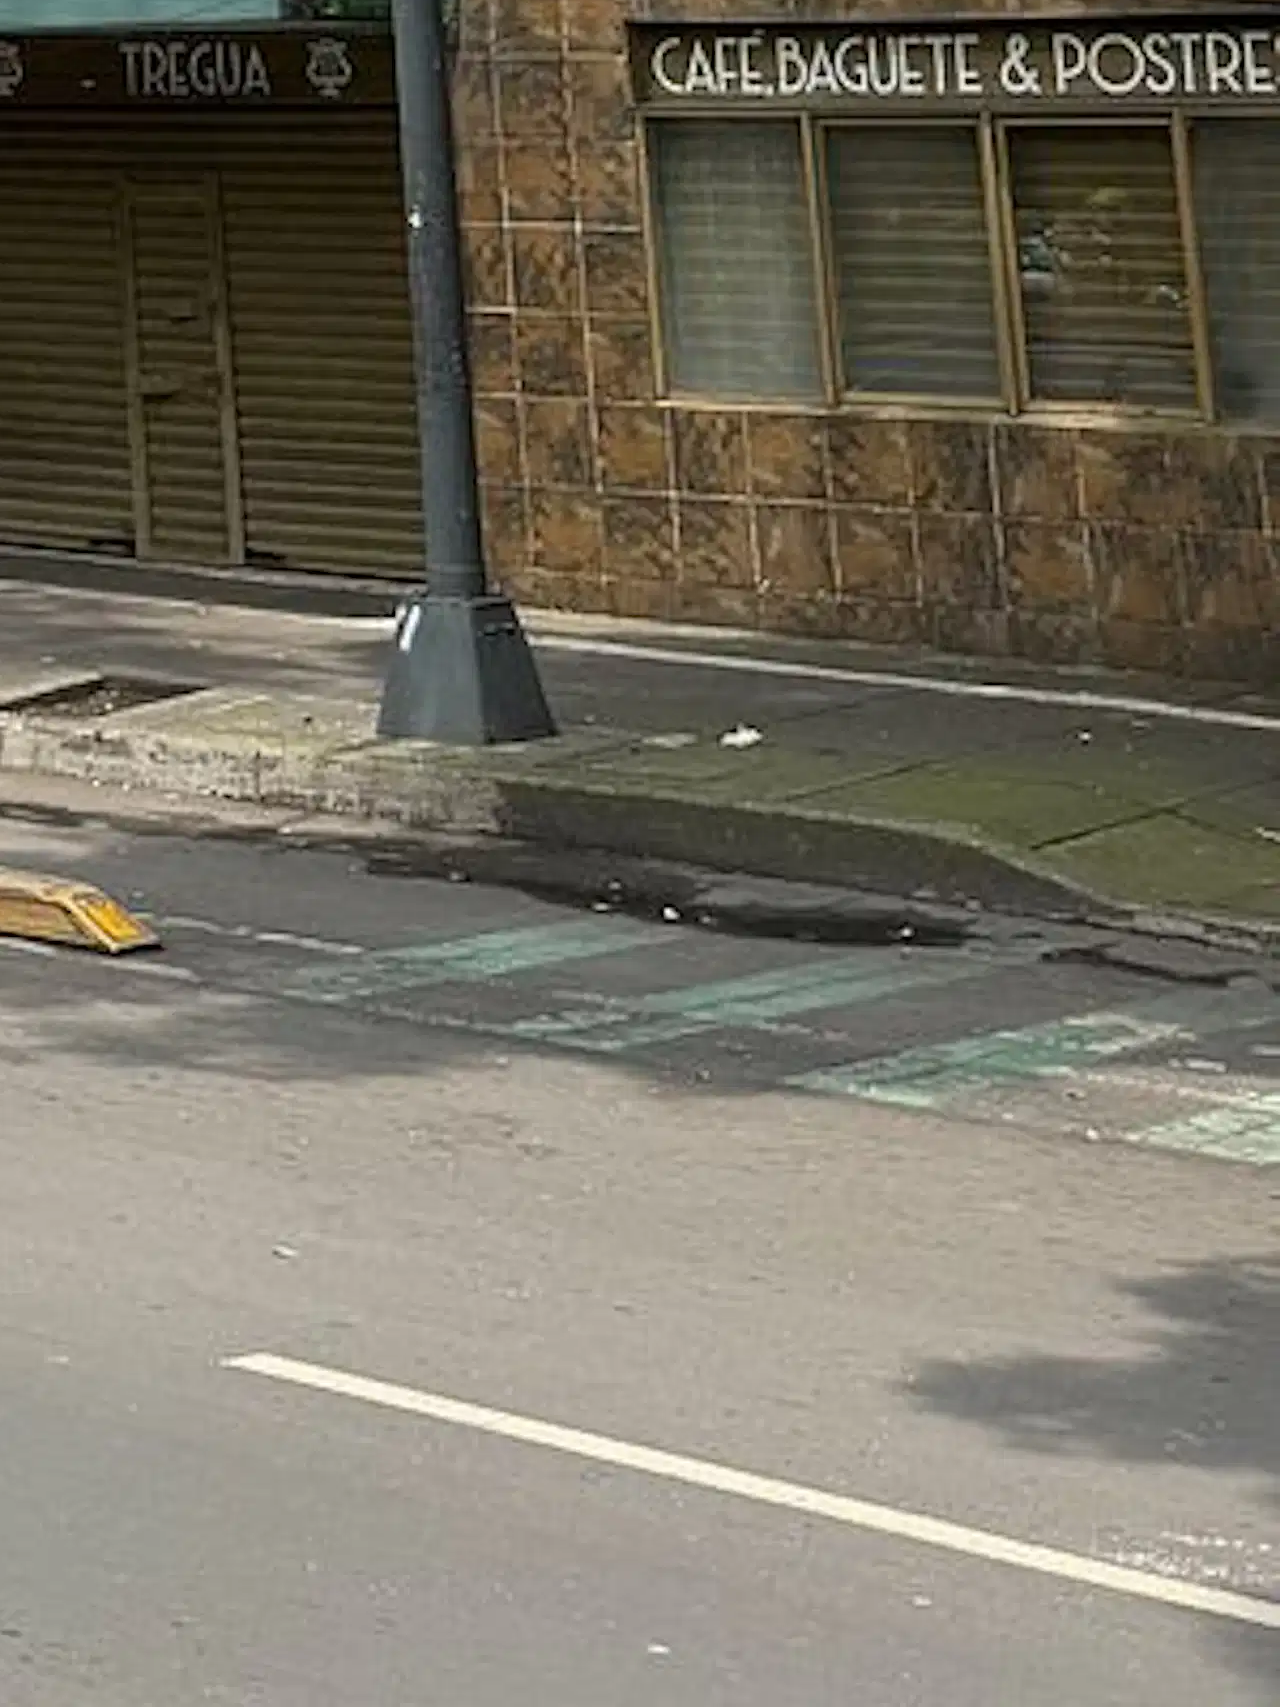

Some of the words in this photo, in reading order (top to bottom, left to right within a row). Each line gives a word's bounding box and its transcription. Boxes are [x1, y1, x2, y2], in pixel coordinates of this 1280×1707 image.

[118, 40, 271, 97] TREGUA
[775, 34, 983, 96] BAGUETE
[1001, 33, 1041, 94] &
[1052, 31, 1280, 95] POSTRE
